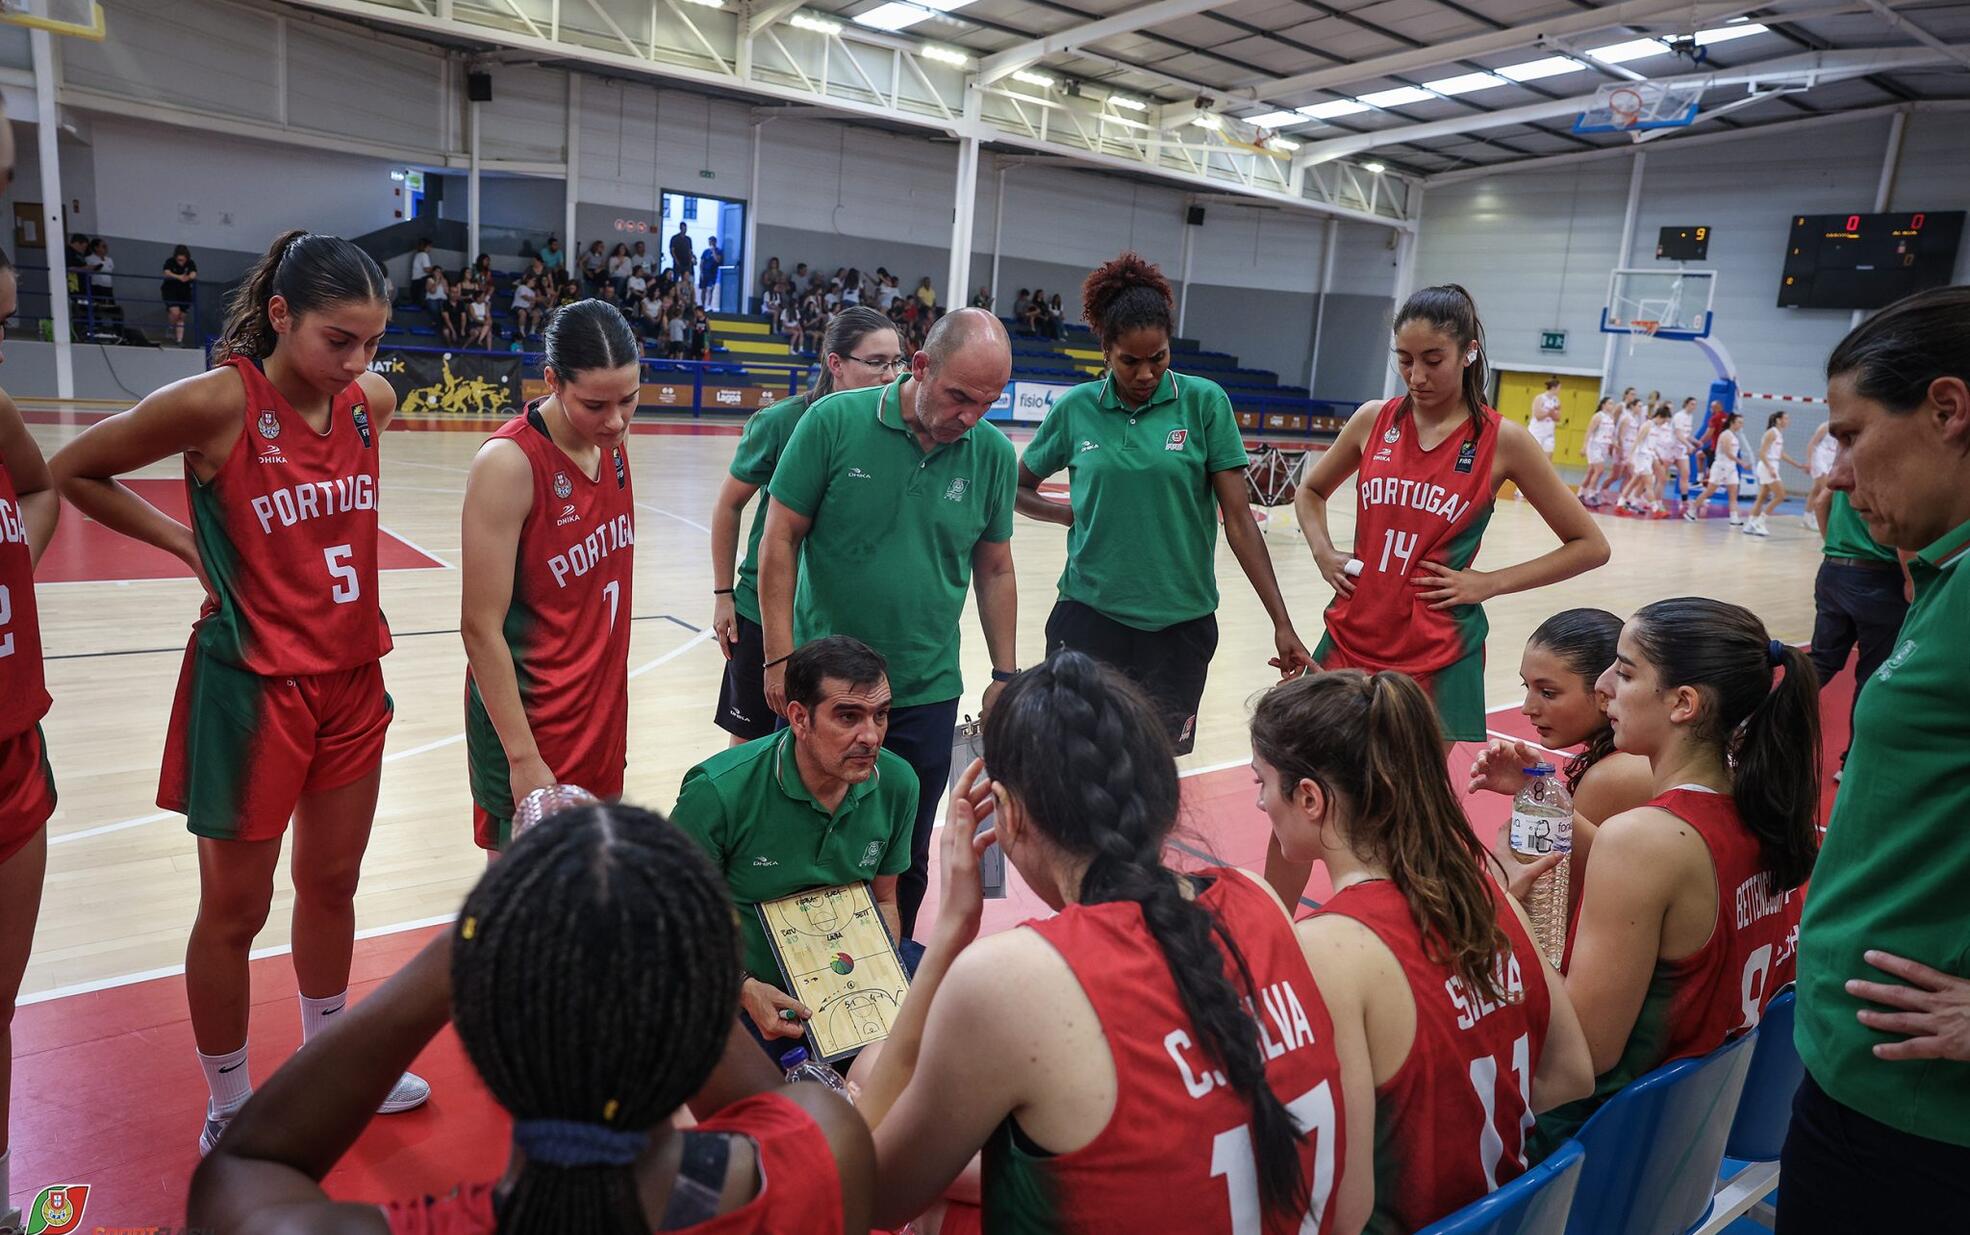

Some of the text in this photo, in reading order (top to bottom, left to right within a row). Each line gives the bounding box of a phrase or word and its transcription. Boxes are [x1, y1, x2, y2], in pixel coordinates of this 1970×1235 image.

[1696, 228, 1706, 241] 9
[1846, 215, 1860, 231] 0
[1911, 214, 1925, 230] 0
[251, 474, 379, 535] PORTUG
[557, 513, 581, 527] DHIKA
[323, 544, 360, 604] 5
[1379, 528, 1418, 576] 14
[1534, 781, 1545, 801] 8
[1163, 1029, 1227, 1099] C.
[1470, 1032, 1535, 1192] 11
[1210, 1078, 1336, 1235] 17
